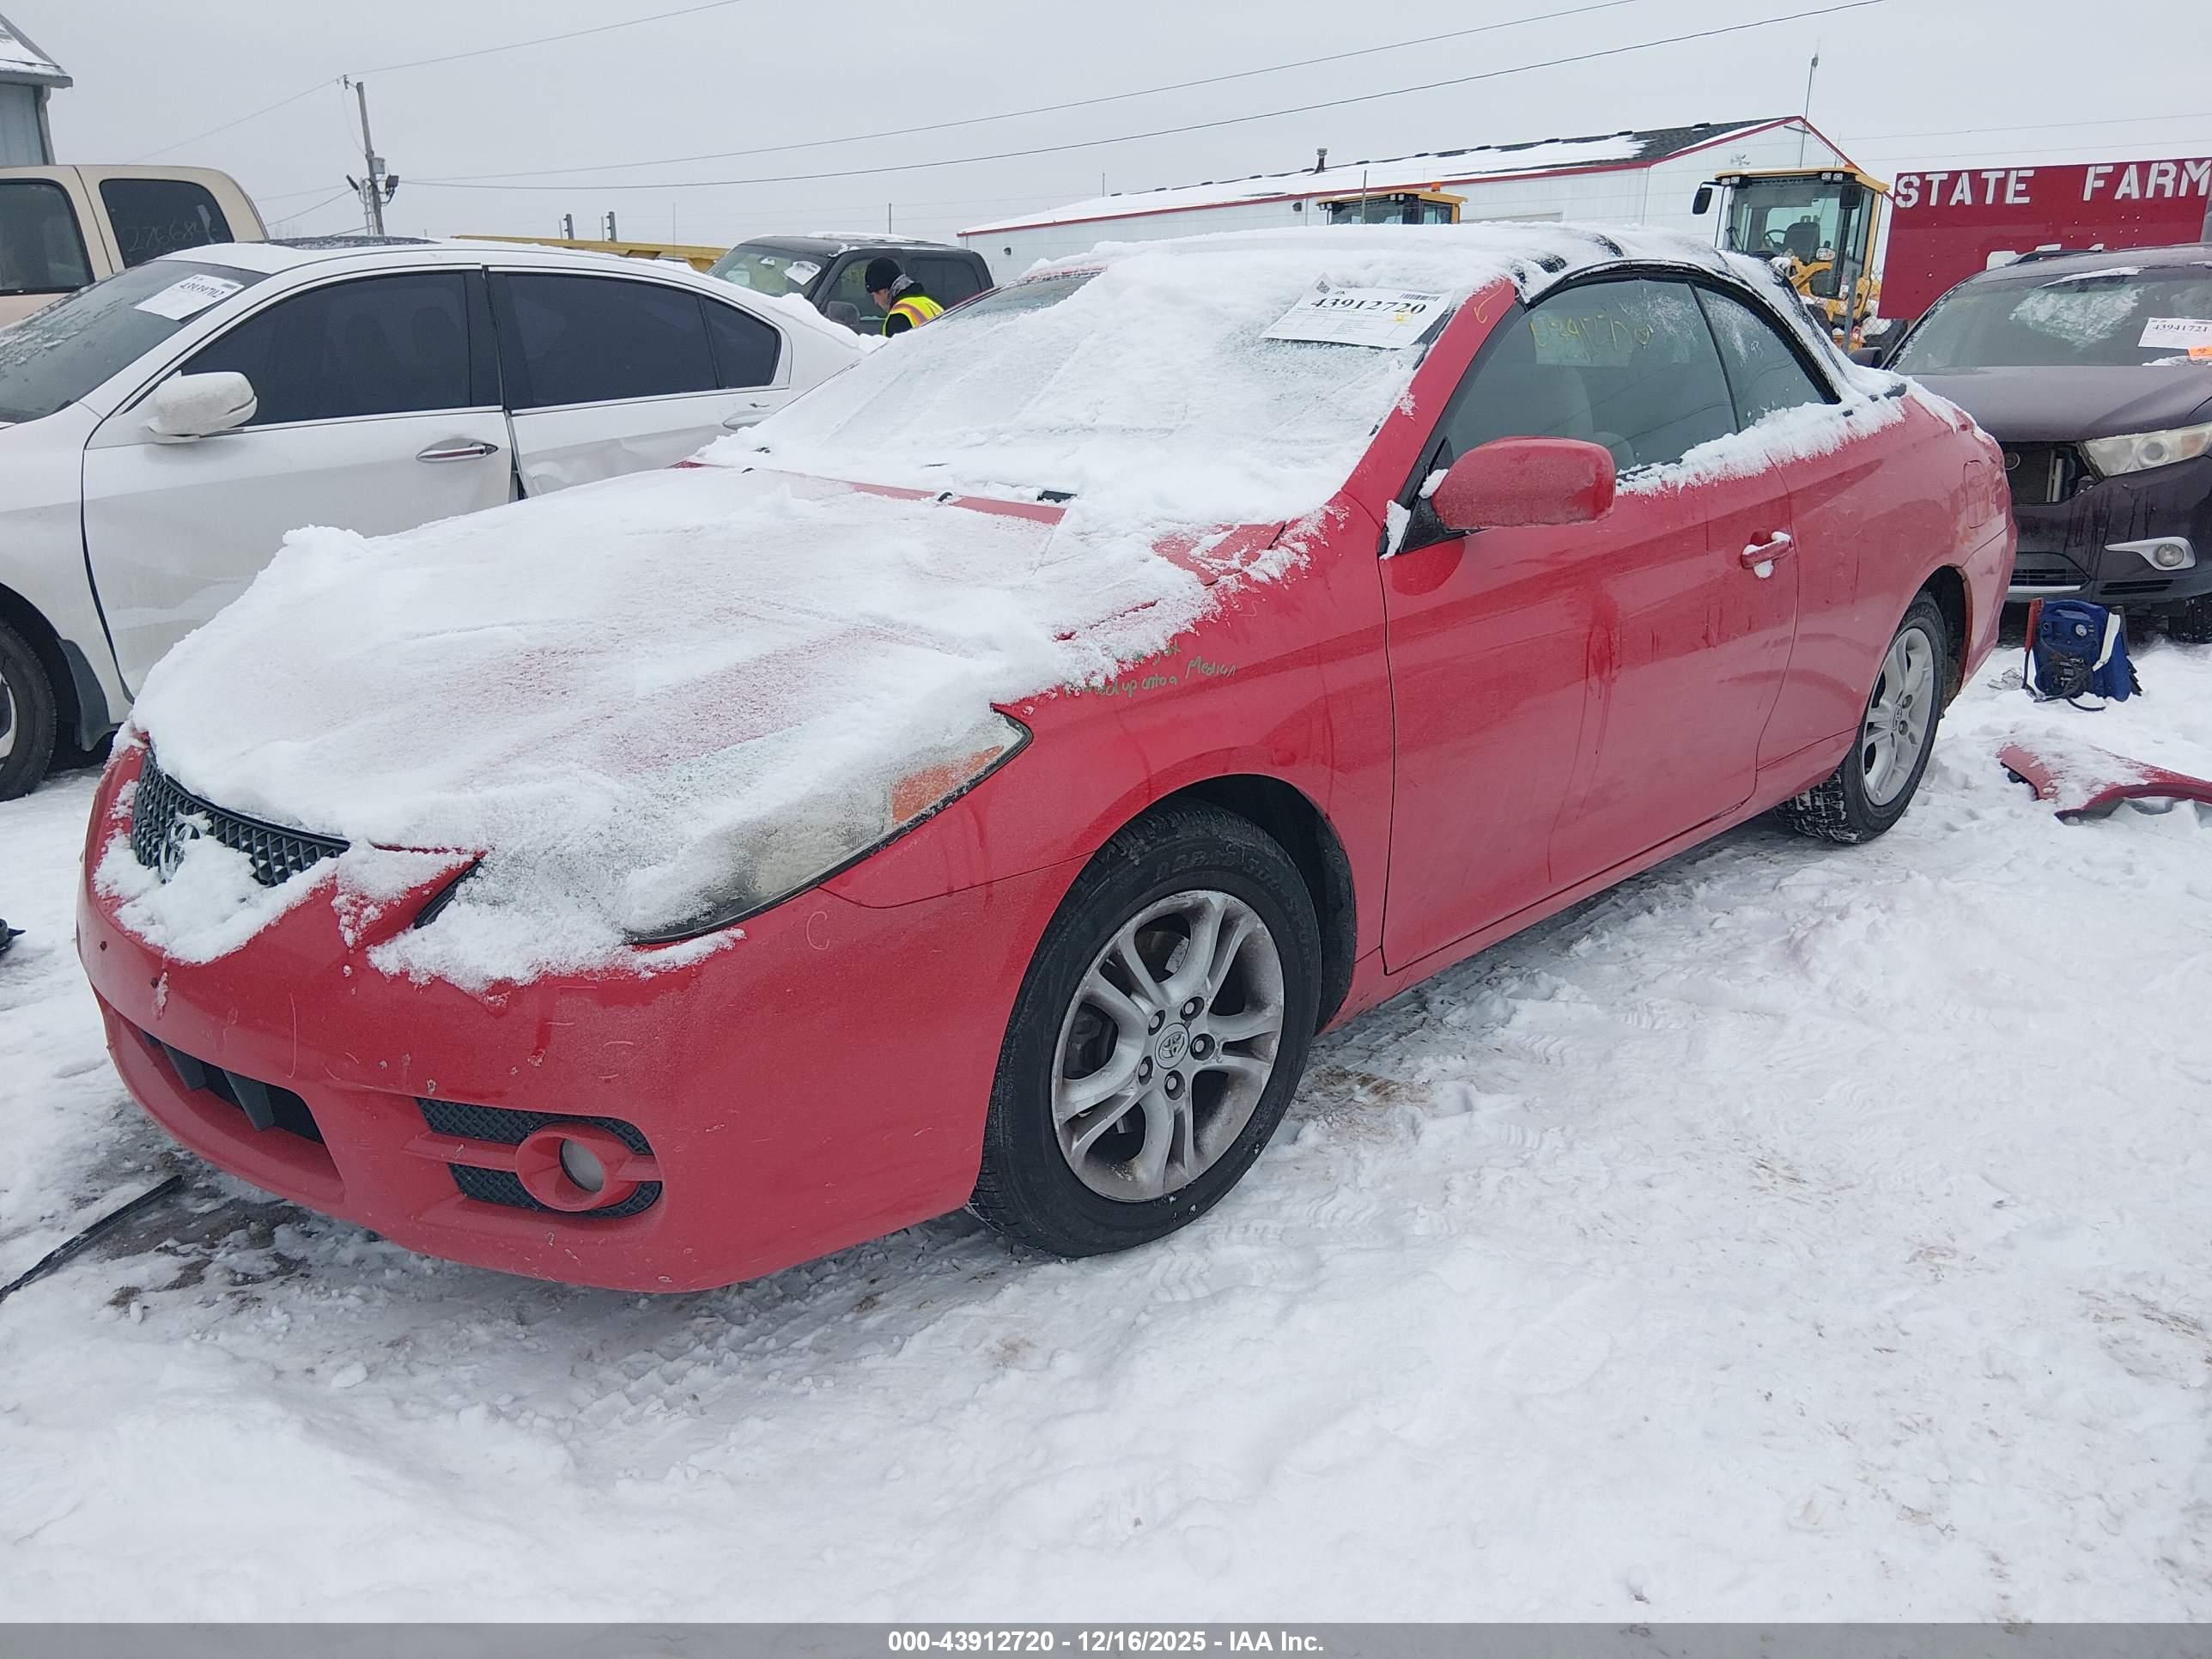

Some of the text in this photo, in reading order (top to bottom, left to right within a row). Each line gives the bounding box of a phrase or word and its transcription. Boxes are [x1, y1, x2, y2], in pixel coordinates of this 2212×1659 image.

[1895, 160, 2212, 208] STATE FARM
[1310, 297, 1427, 315] 43912720
